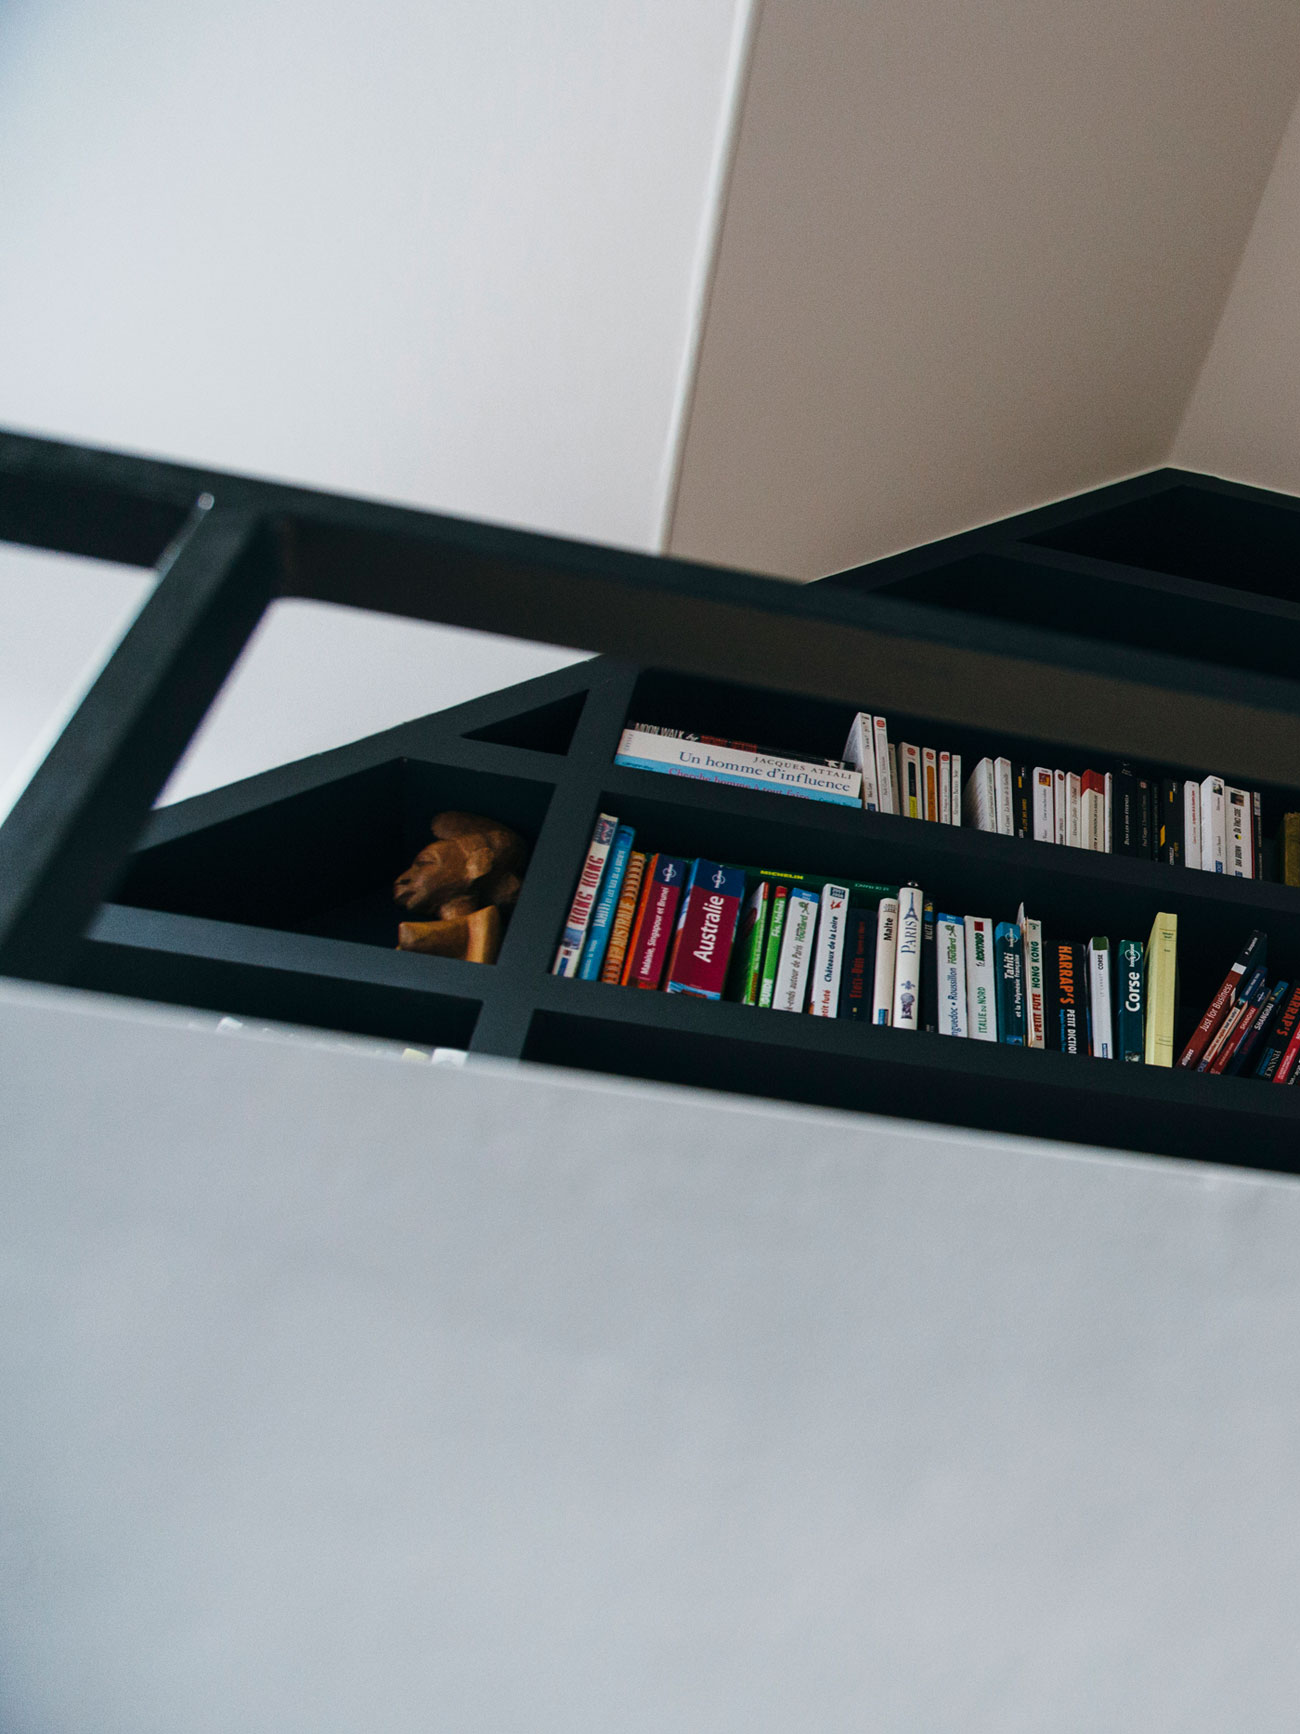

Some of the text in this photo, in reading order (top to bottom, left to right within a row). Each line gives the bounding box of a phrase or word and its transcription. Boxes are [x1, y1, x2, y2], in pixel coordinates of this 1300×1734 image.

[679, 750, 851, 792] Un homme d'influence
[753, 757, 852, 780] JACQUES ATTALI
[569, 891, 593, 925] HONG
[581, 855, 604, 888] KONG
[592, 902, 610, 927] TAHITI
[610, 901, 635, 948] AUSTRALIE
[640, 886, 669, 975] Malaisie, Singapour et Brunei
[693, 895, 725, 963] Australie
[883, 917, 894, 941] Malte
[901, 920, 917, 954] PARIS
[792, 944, 804, 960] Paris
[823, 915, 839, 983] Châteaux de la Loire
[1030, 941, 1040, 963] KONG
[790, 959, 800, 969] de
[1004, 952, 1015, 980] Tahiti
[1013, 954, 1021, 981] française
[1031, 965, 1041, 988] HONG
[1058, 945, 1074, 1005] HARRAP'S
[789, 968, 799, 990] autour
[947, 967, 958, 1001] Roussillon
[1014, 979, 1023, 1004] Polynésie
[1125, 971, 1141, 1013] Corse
[821, 989, 831, 1004] futé
[978, 986, 986, 1004] NORD
[1200, 983, 1233, 1032] Just for Business
[978, 1012, 987, 1034] ITALIE
[1033, 1012, 1043, 1033] PETIT
[1067, 1008, 1076, 1027] PETIT
[1240, 1007, 1257, 1030] SHANGHAI
[1254, 1002, 1274, 1031] SHANGHAI
[1264, 1049, 1282, 1079] FINANCE
